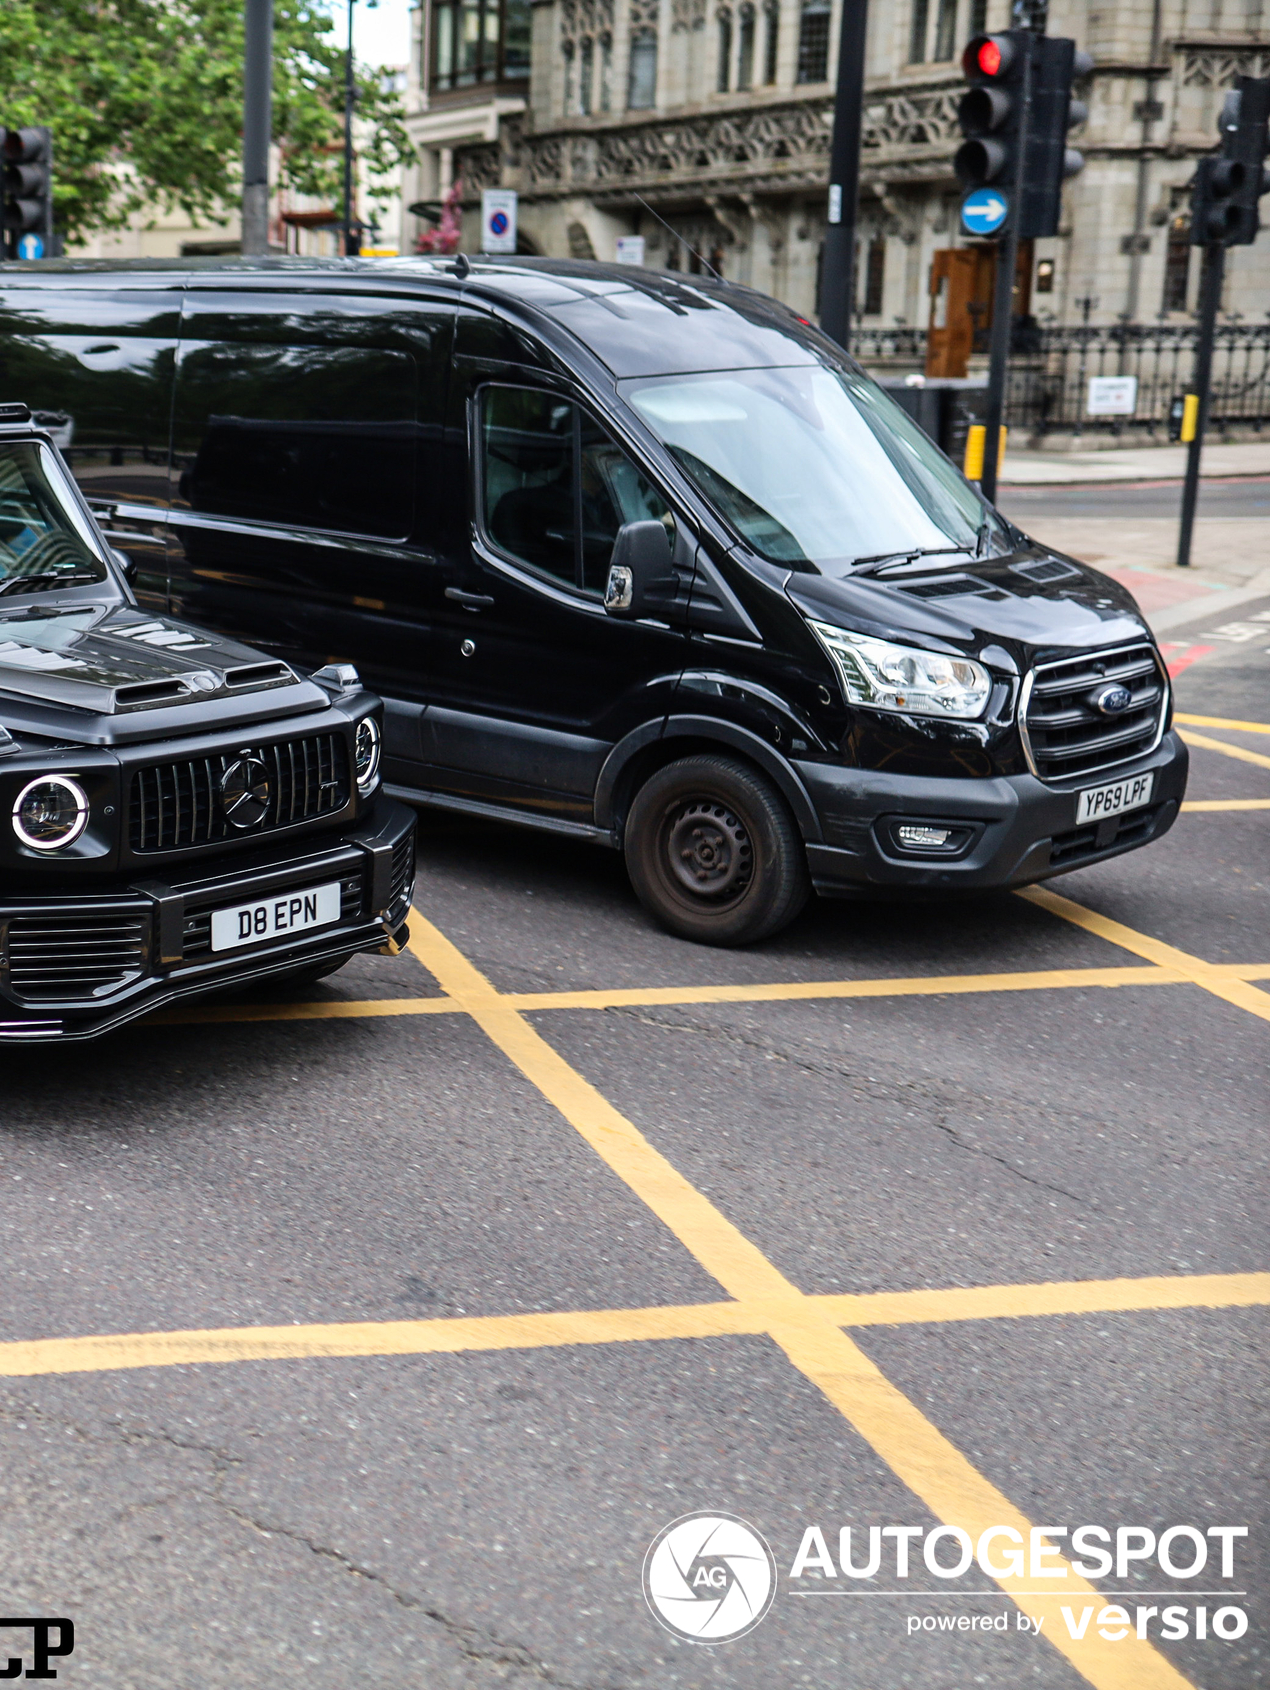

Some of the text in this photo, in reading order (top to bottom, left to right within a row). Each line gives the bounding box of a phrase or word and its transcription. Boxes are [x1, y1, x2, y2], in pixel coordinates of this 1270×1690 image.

[1086, 777, 1148, 817] YP69 LPF
[238, 893, 317, 940] D8 EPN
